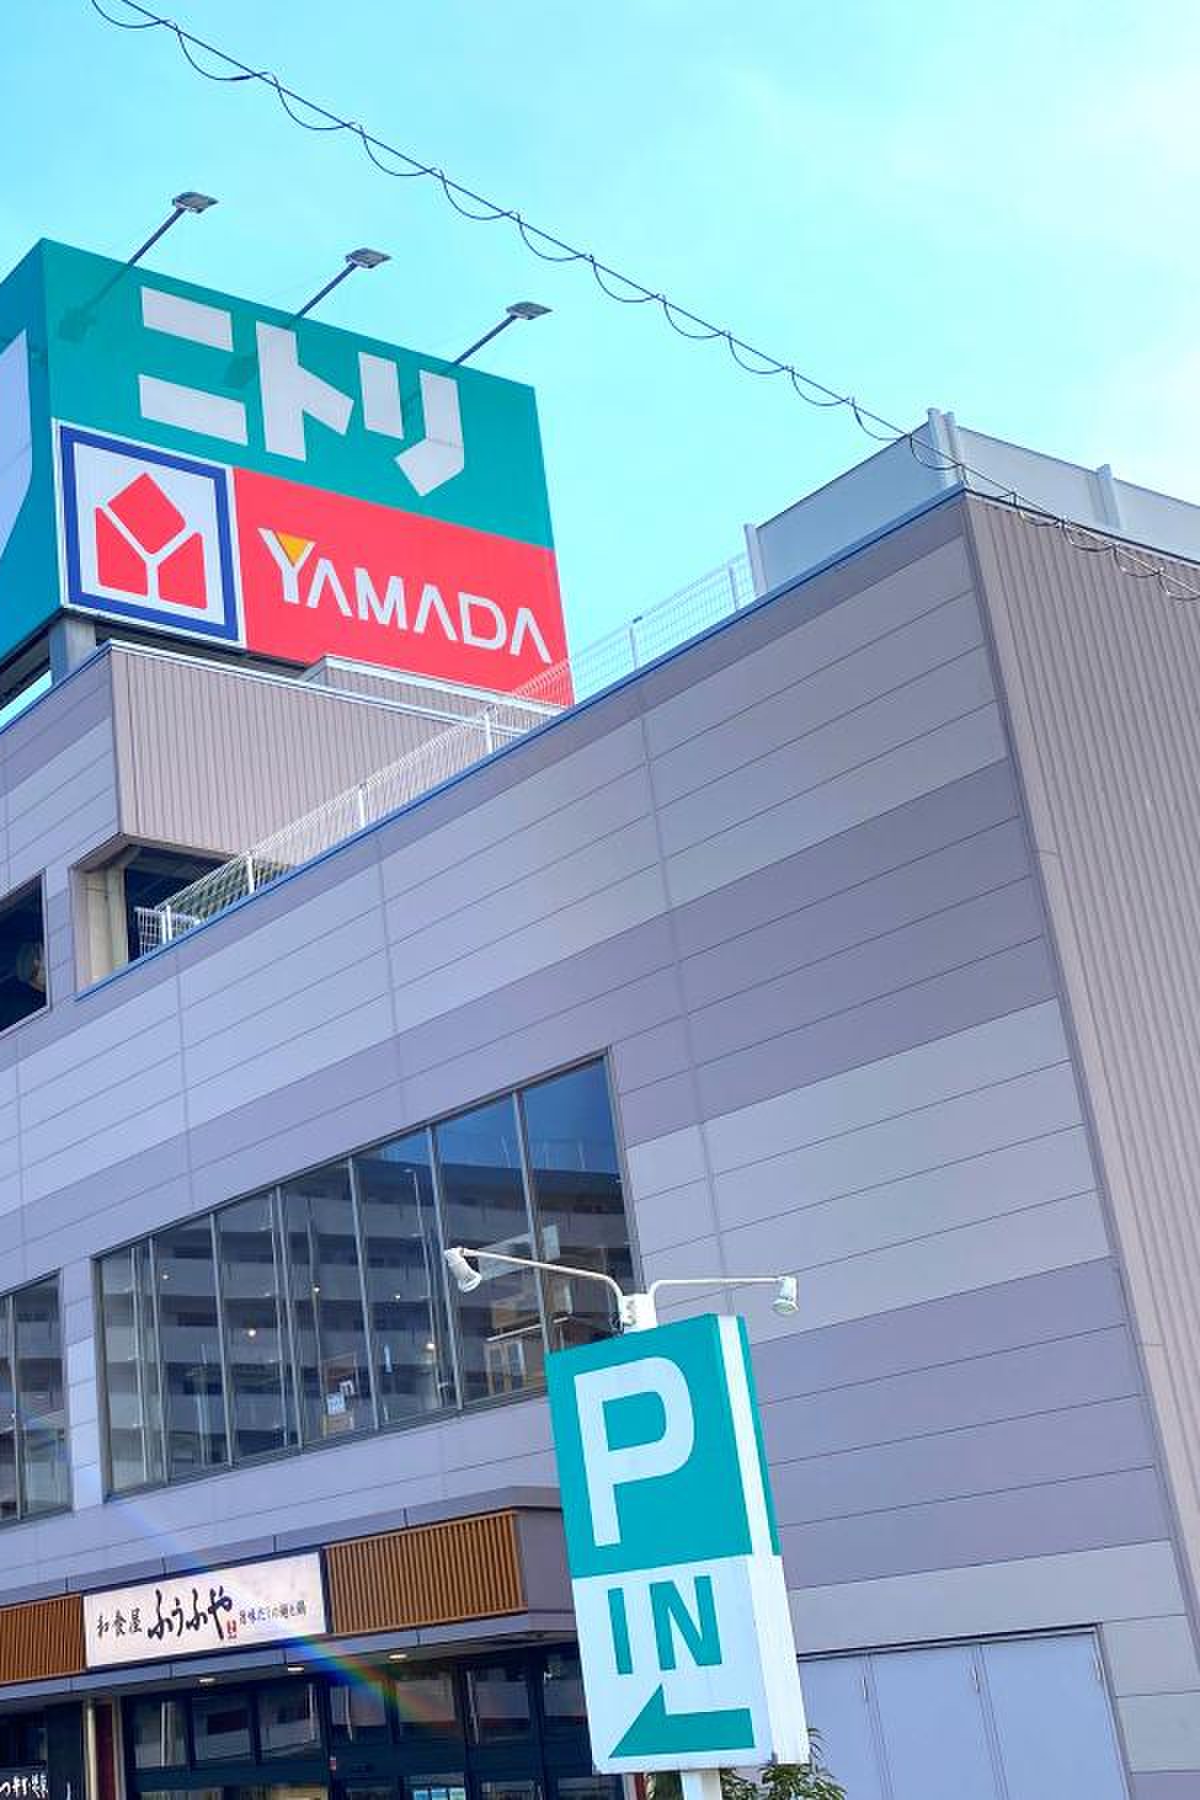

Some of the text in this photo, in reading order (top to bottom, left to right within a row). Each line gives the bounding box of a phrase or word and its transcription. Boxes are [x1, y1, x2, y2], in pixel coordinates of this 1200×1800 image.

[138, 286, 465, 496] ニトリ
[257, 527, 552, 664] YAMADA
[573, 1356, 696, 1547] P
[147, 1585, 233, 1641] ふうふや
[607, 1575, 723, 1676] IN
